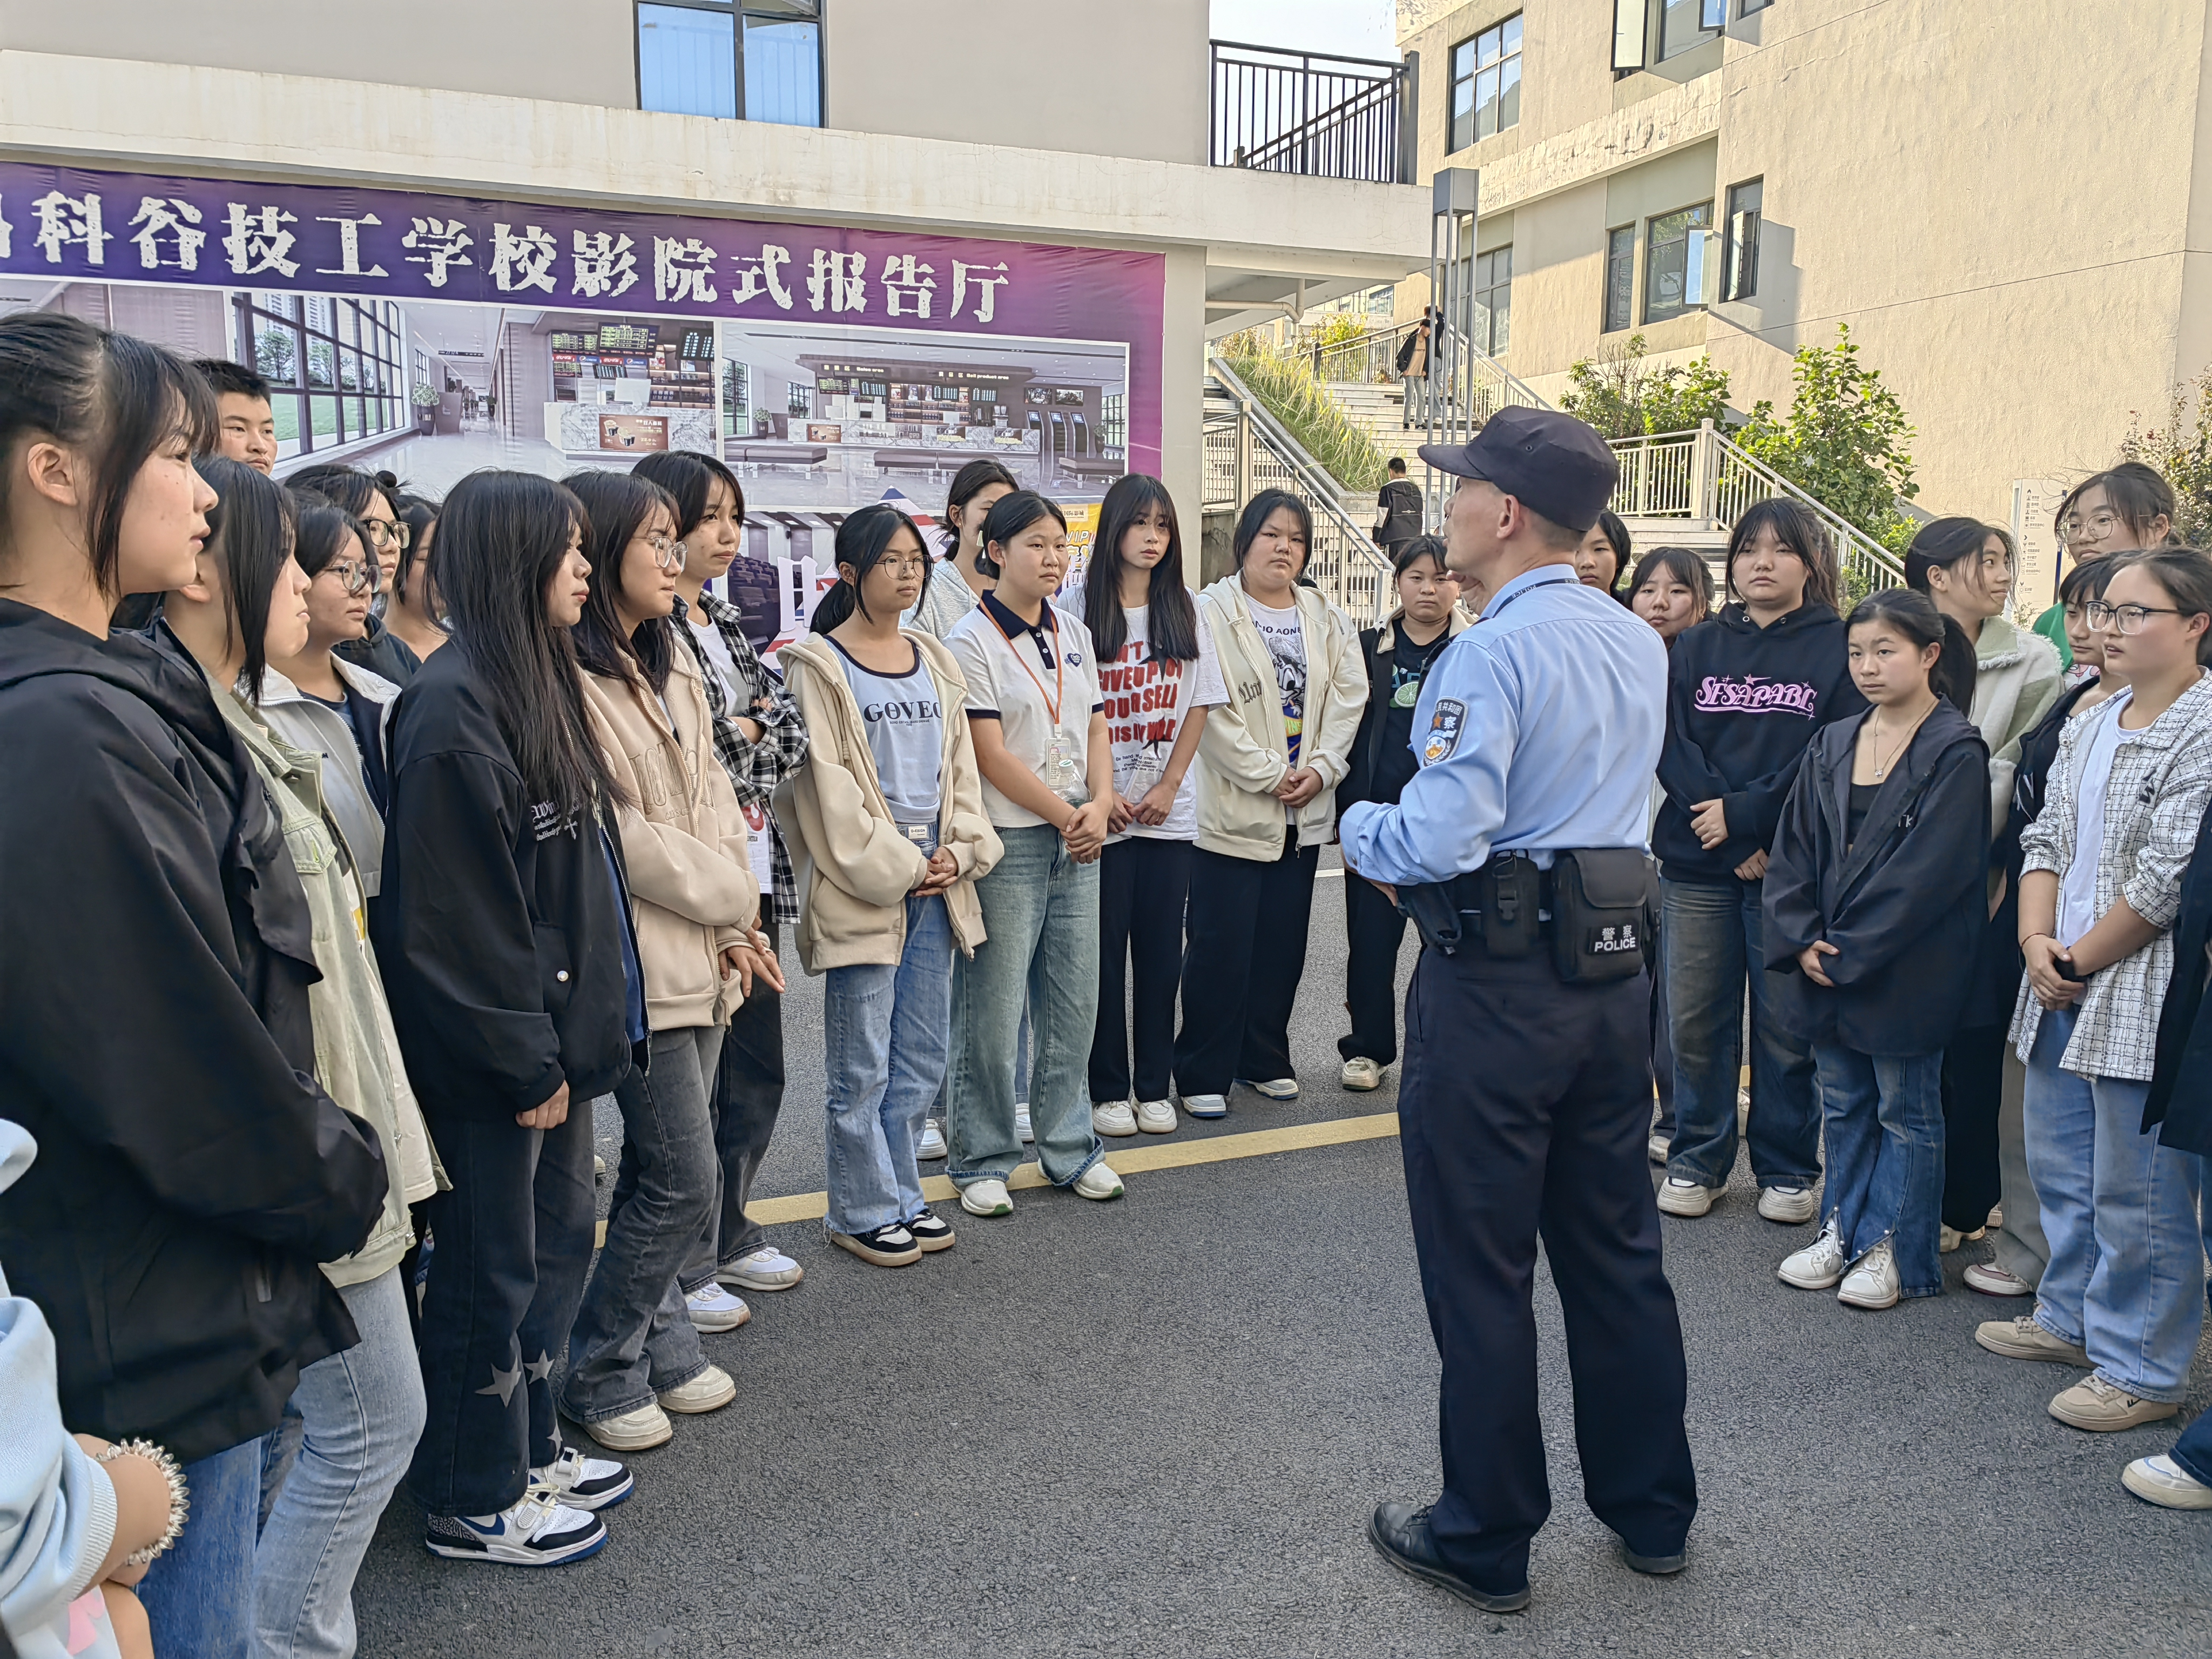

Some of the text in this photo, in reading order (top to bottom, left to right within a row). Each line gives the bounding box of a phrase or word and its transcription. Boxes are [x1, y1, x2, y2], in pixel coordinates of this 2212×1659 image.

[0, 190, 1009, 323] 科谷技工学校影院式报告厅
[1066, 530, 1089, 543] VIP
[1512, 584, 1537, 599] POLICE
[1435, 702, 1463, 716] 民共和国
[1602, 925, 1632, 941] 警察
[1594, 937, 1636, 952] POLICE
